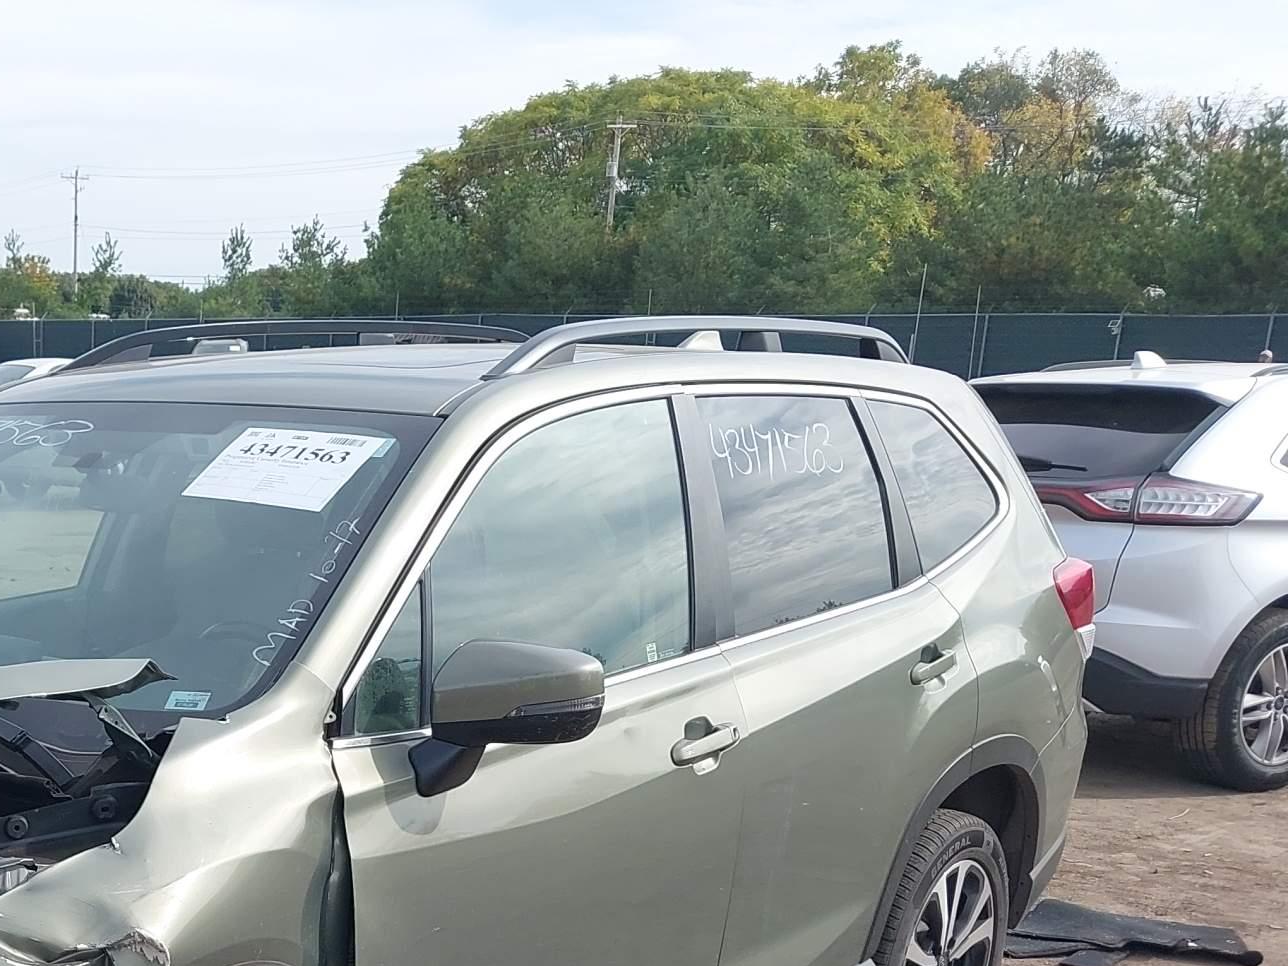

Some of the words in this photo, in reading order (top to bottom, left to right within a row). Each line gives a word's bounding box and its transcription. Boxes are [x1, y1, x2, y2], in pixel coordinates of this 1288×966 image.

[238, 441, 351, 465] 43471563
[709, 423, 844, 480] 43471563
[252, 599, 314, 666] MAD
[931, 835, 972, 879] GENERAL
